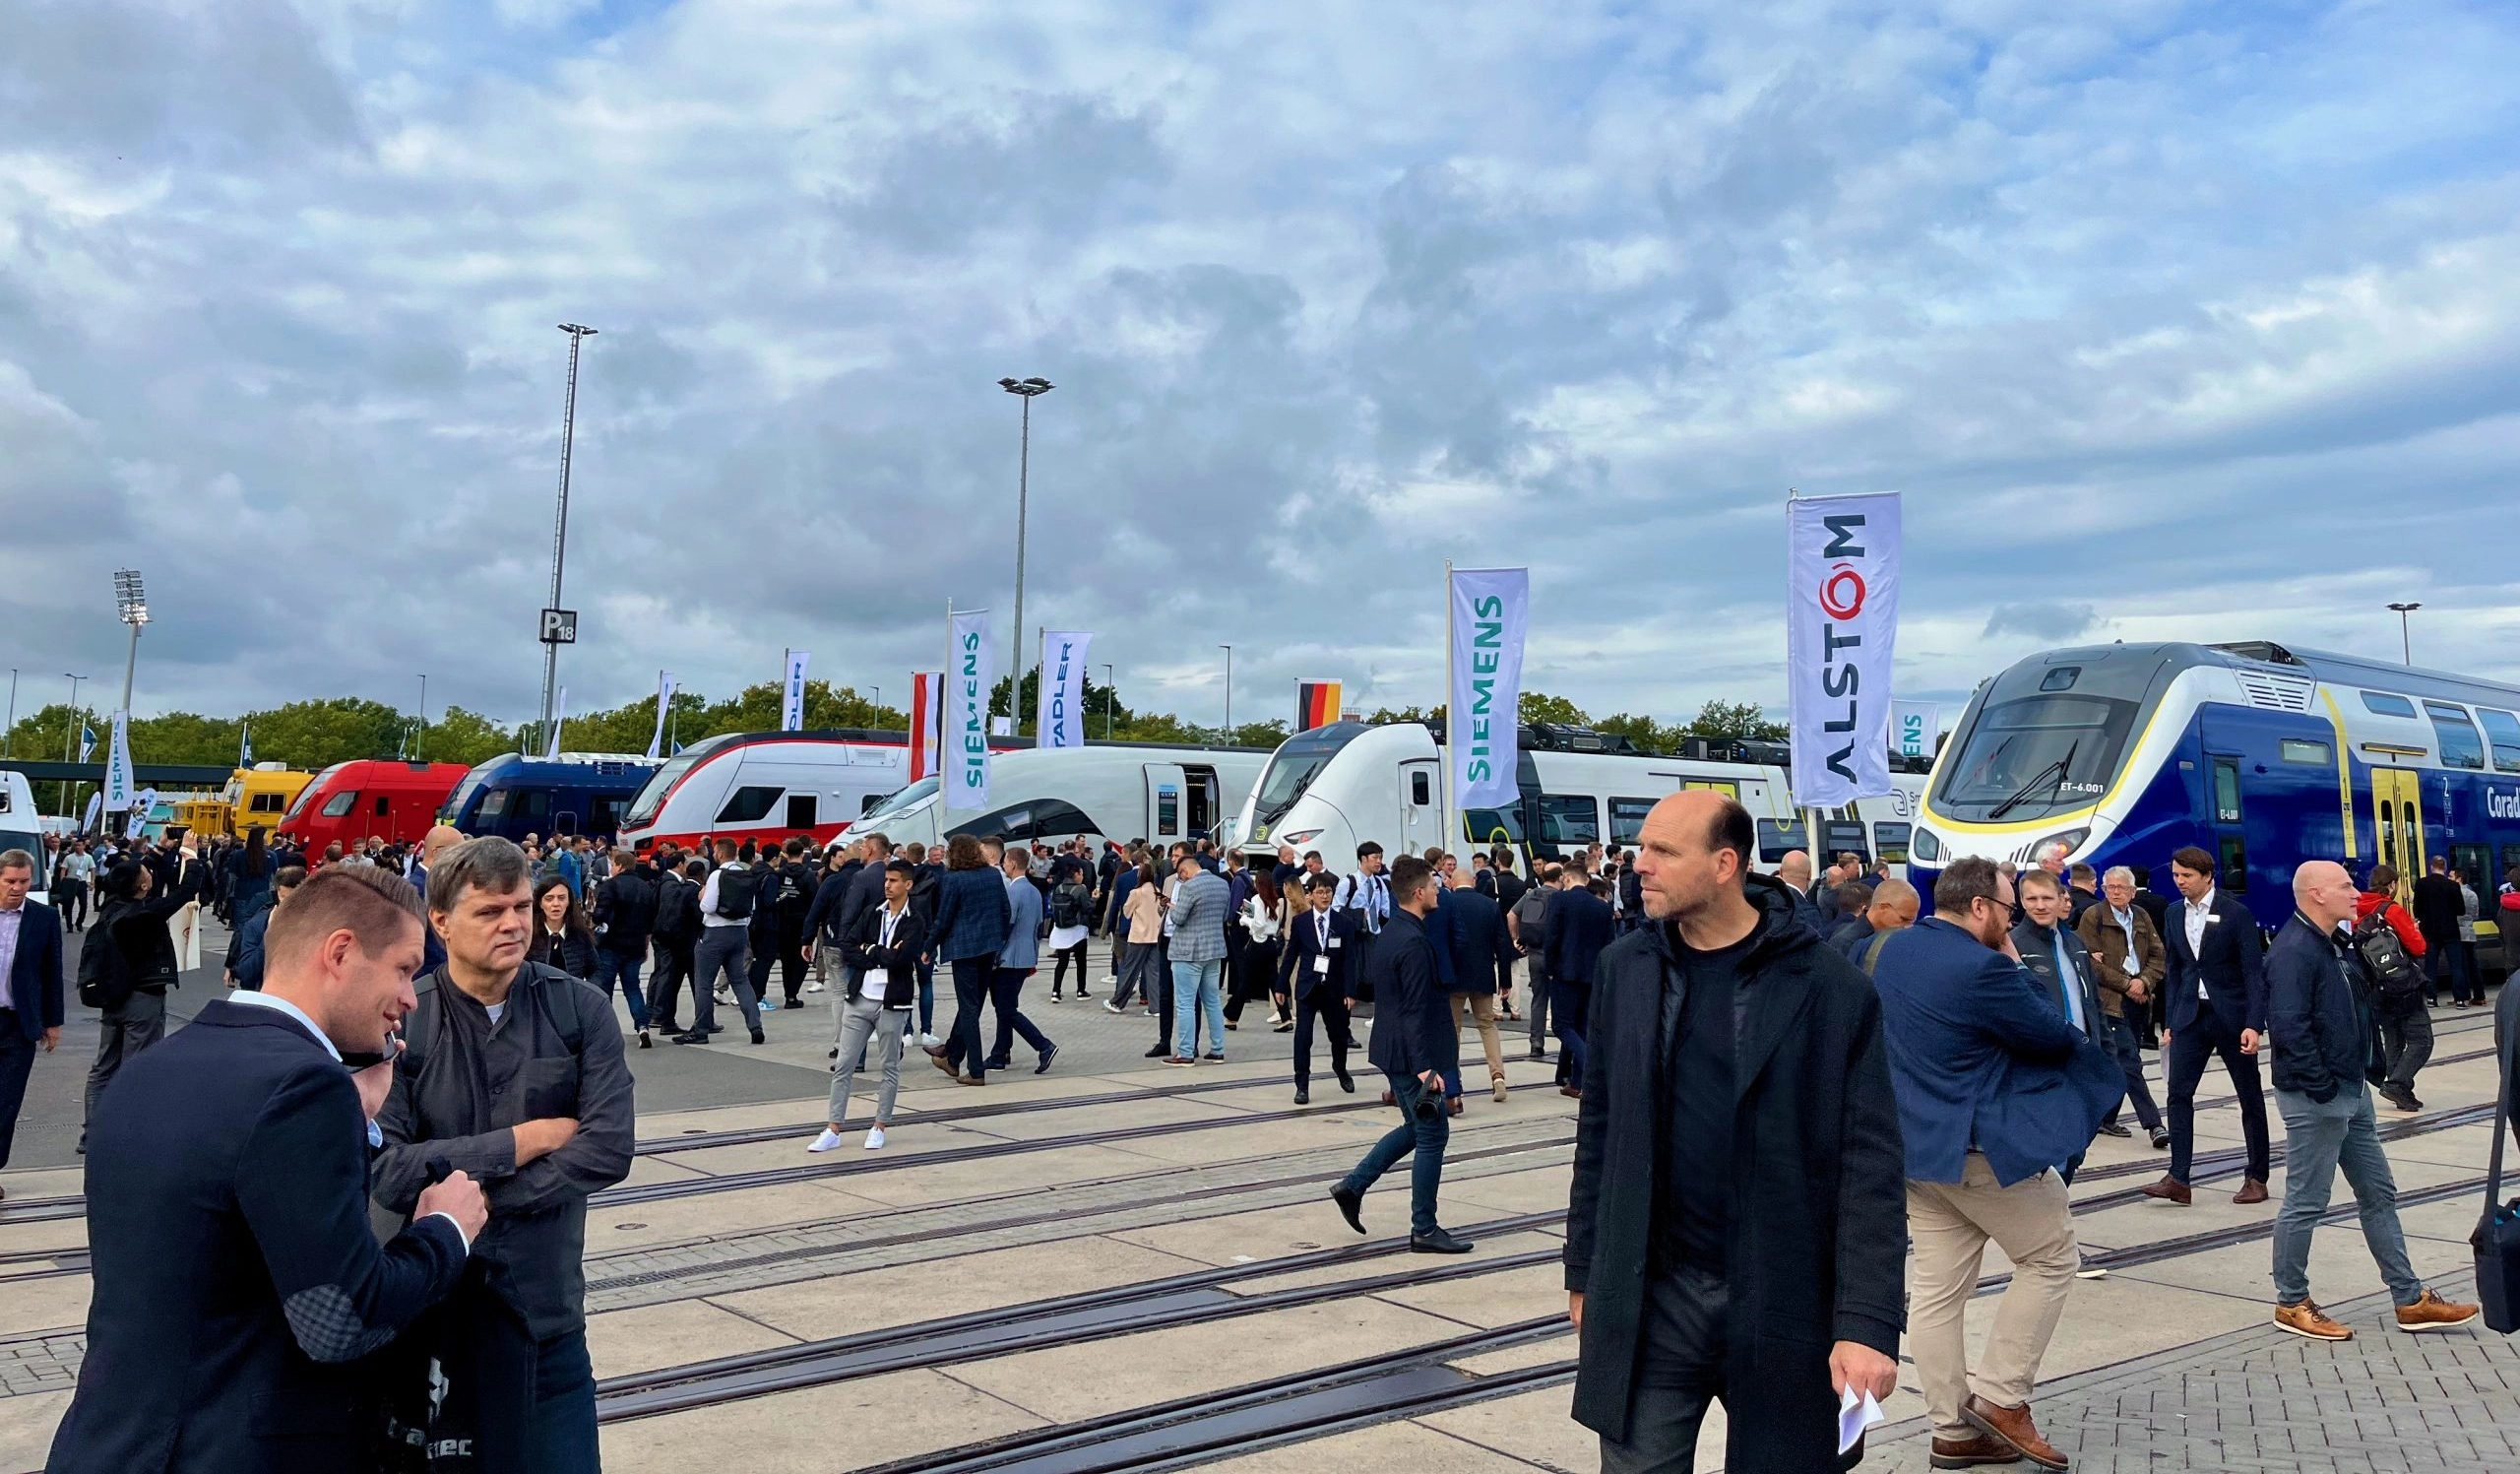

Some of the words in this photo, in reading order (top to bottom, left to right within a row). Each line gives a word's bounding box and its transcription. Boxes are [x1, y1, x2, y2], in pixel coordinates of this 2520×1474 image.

[963, 631, 983, 788] SIEMENS
[1467, 595, 1502, 783] SIEMENS
[1819, 514, 1866, 785] ALSTOM
[2060, 782, 2104, 794] ET-6.001
